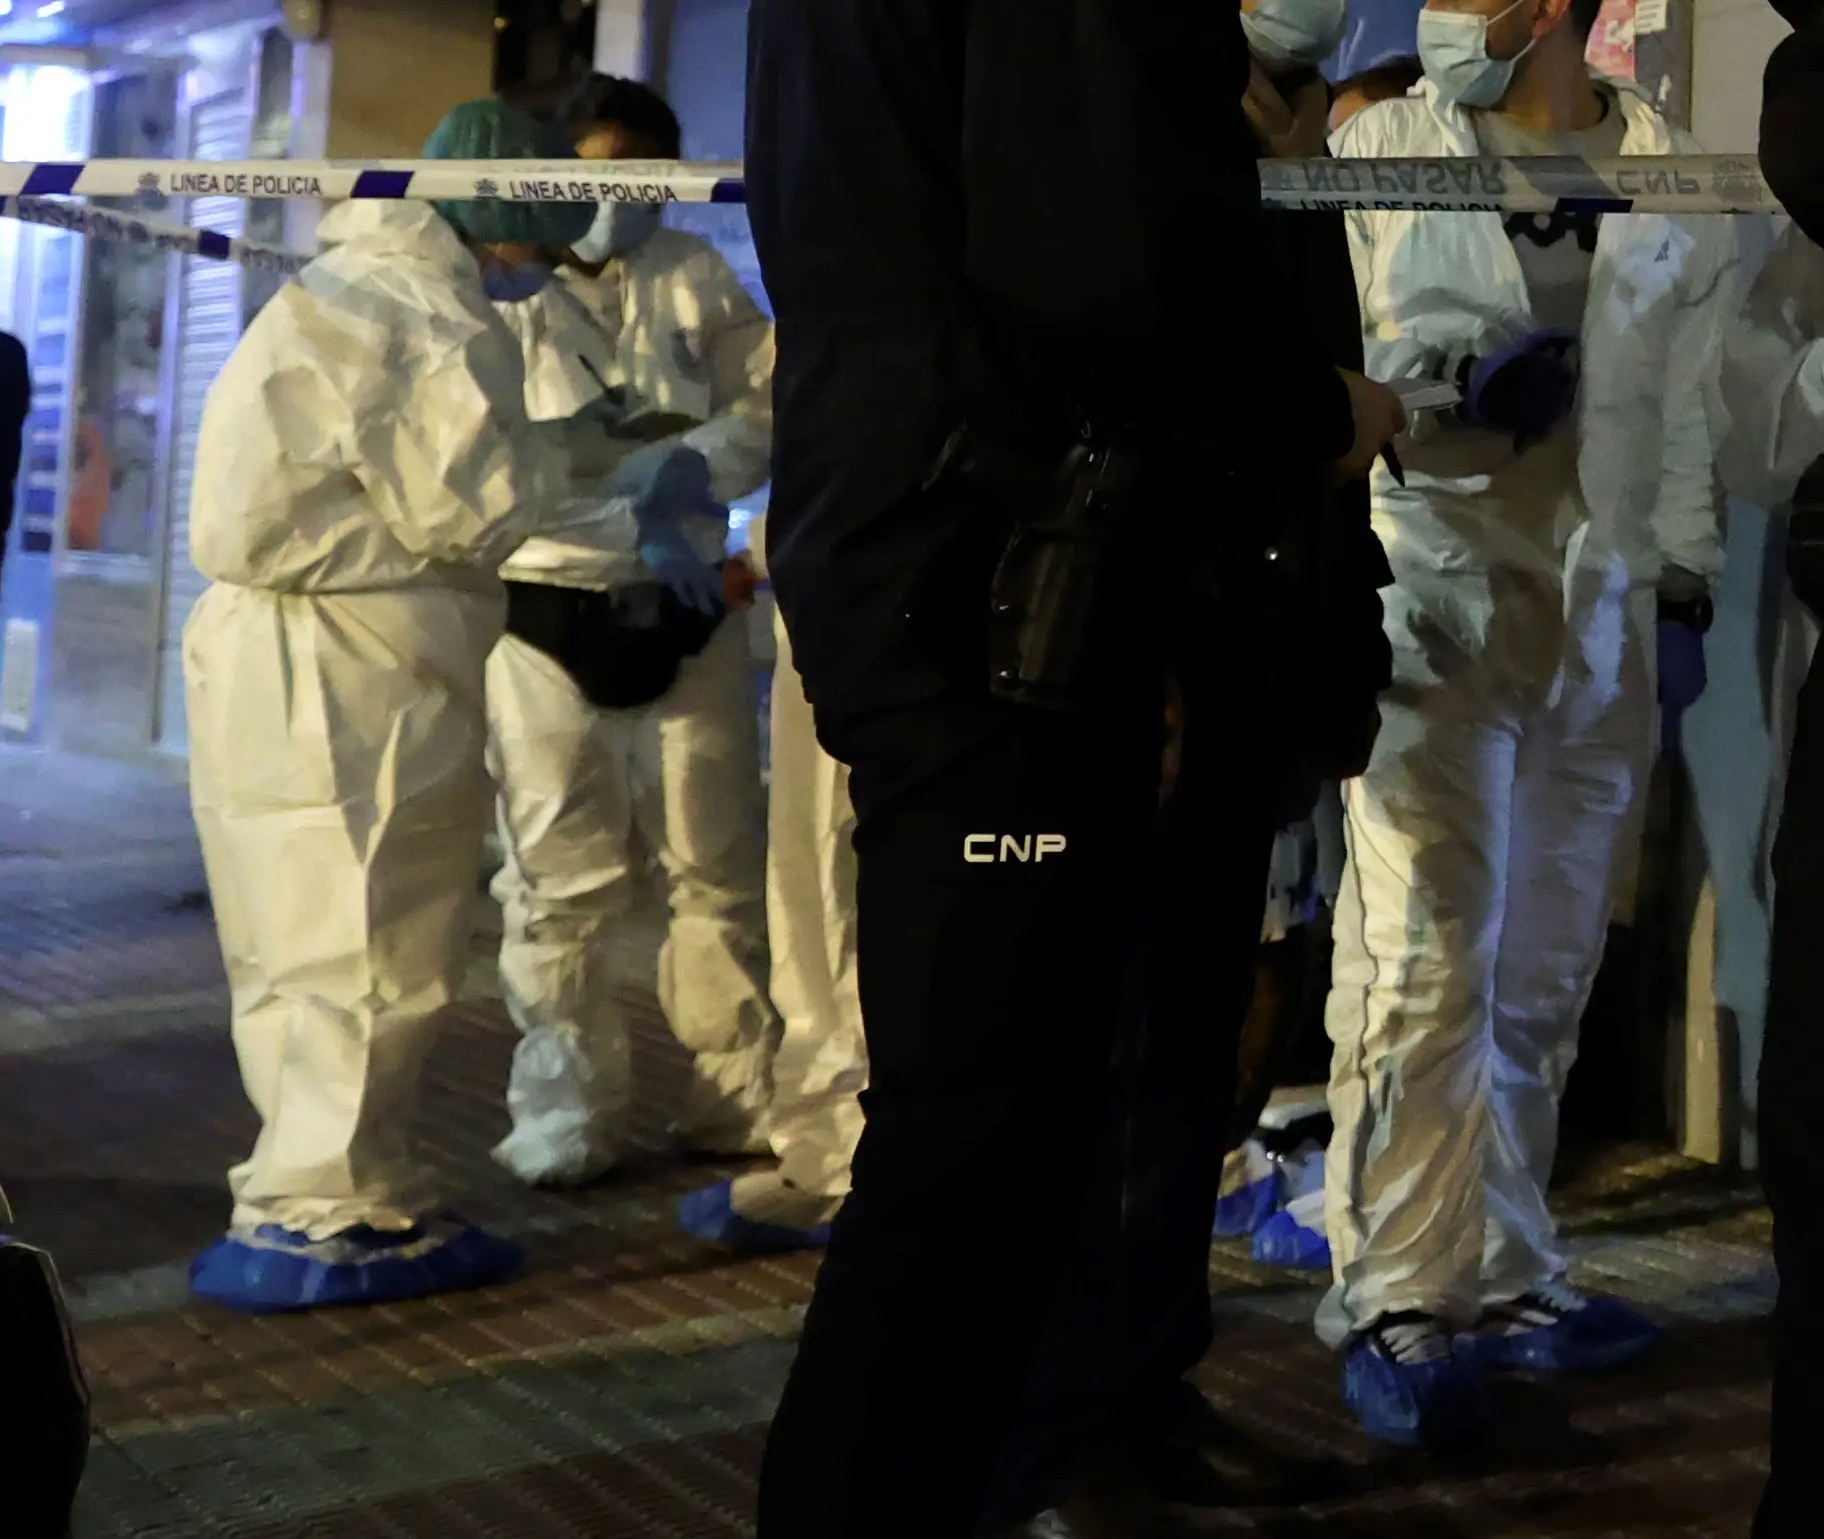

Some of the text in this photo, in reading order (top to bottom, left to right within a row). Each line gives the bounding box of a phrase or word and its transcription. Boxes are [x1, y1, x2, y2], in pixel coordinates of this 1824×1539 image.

[170, 172, 323, 197] LINEA DE POLICIA
[509, 180, 679, 203] LINEA DE POLICIA
[962, 832, 1068, 864] CNP
